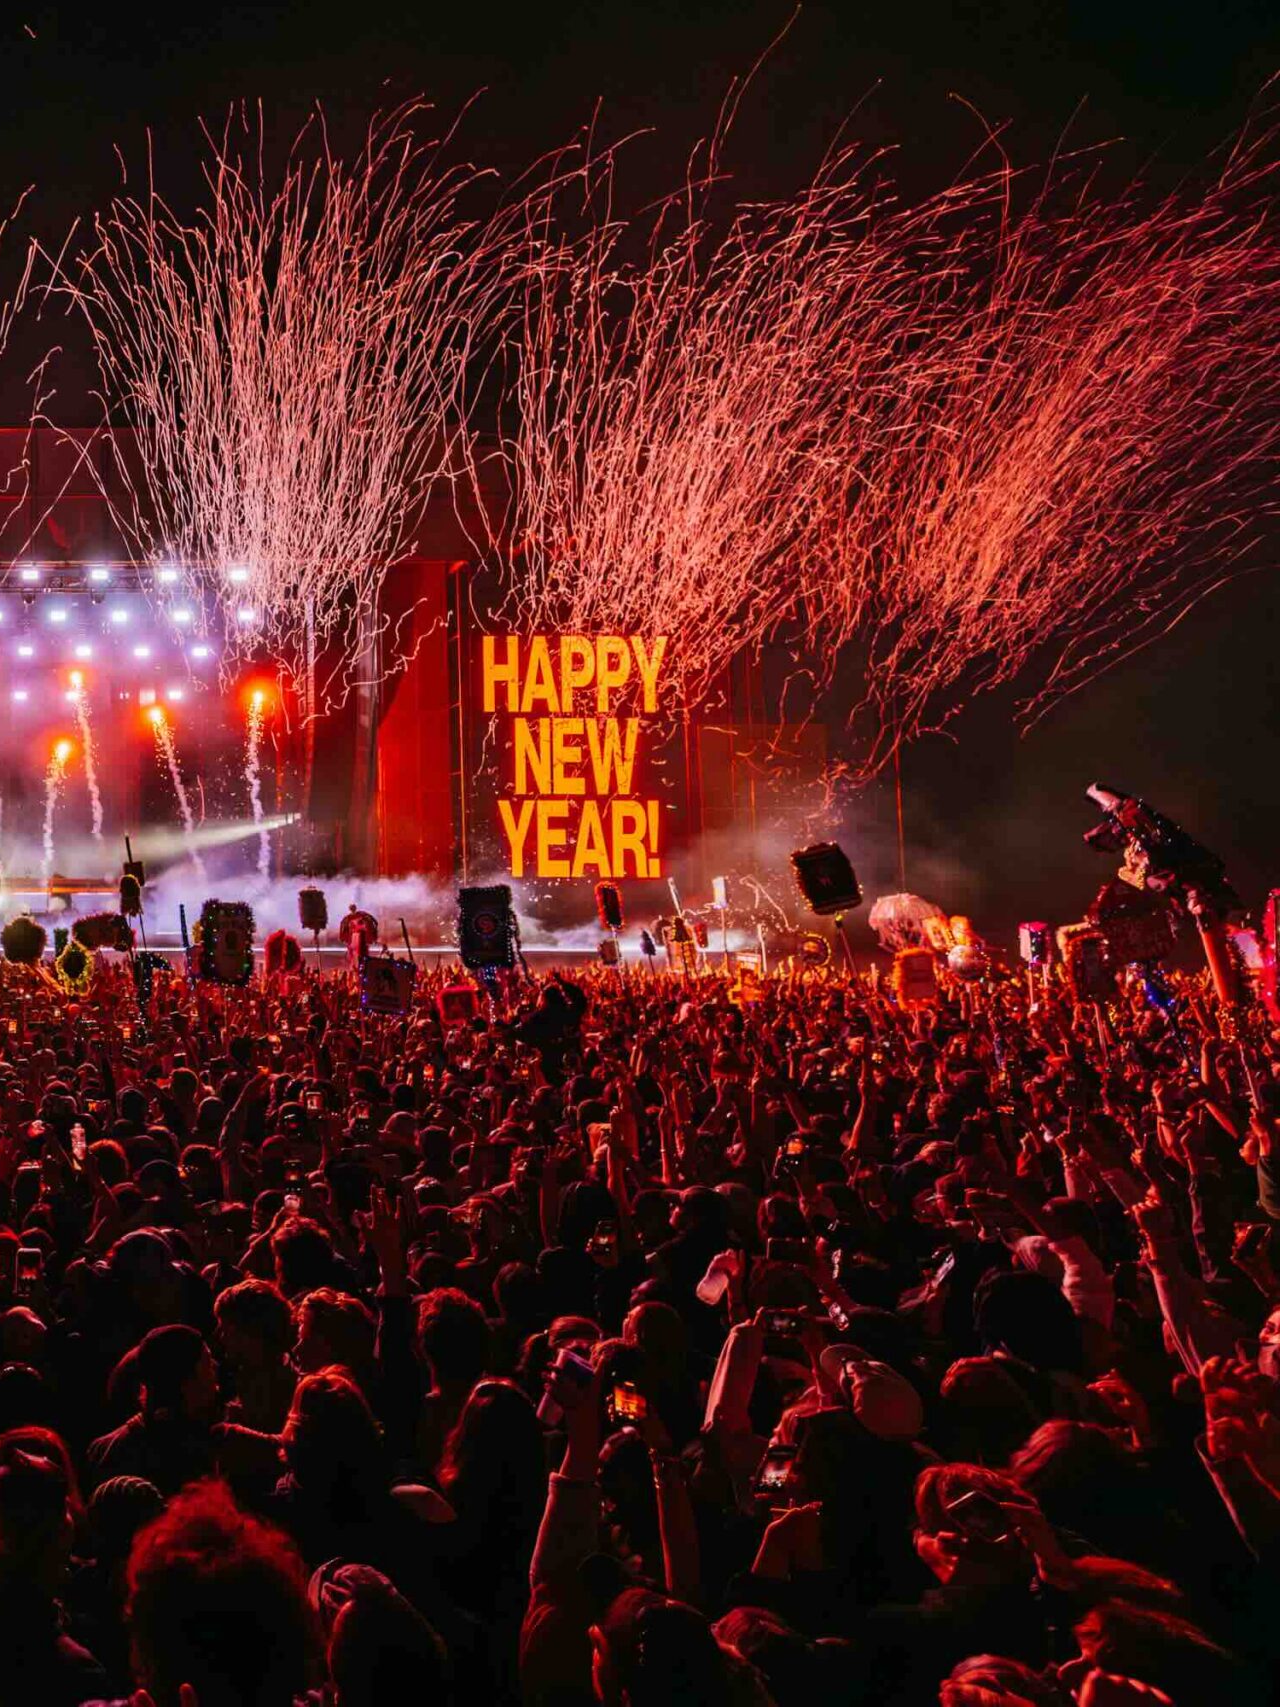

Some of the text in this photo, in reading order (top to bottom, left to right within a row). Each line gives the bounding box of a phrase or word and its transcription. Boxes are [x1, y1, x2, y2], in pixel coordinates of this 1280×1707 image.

[482, 635, 669, 713] HAPPY
[514, 717, 639, 795] NEW
[497, 799, 661, 878] YEAR!
